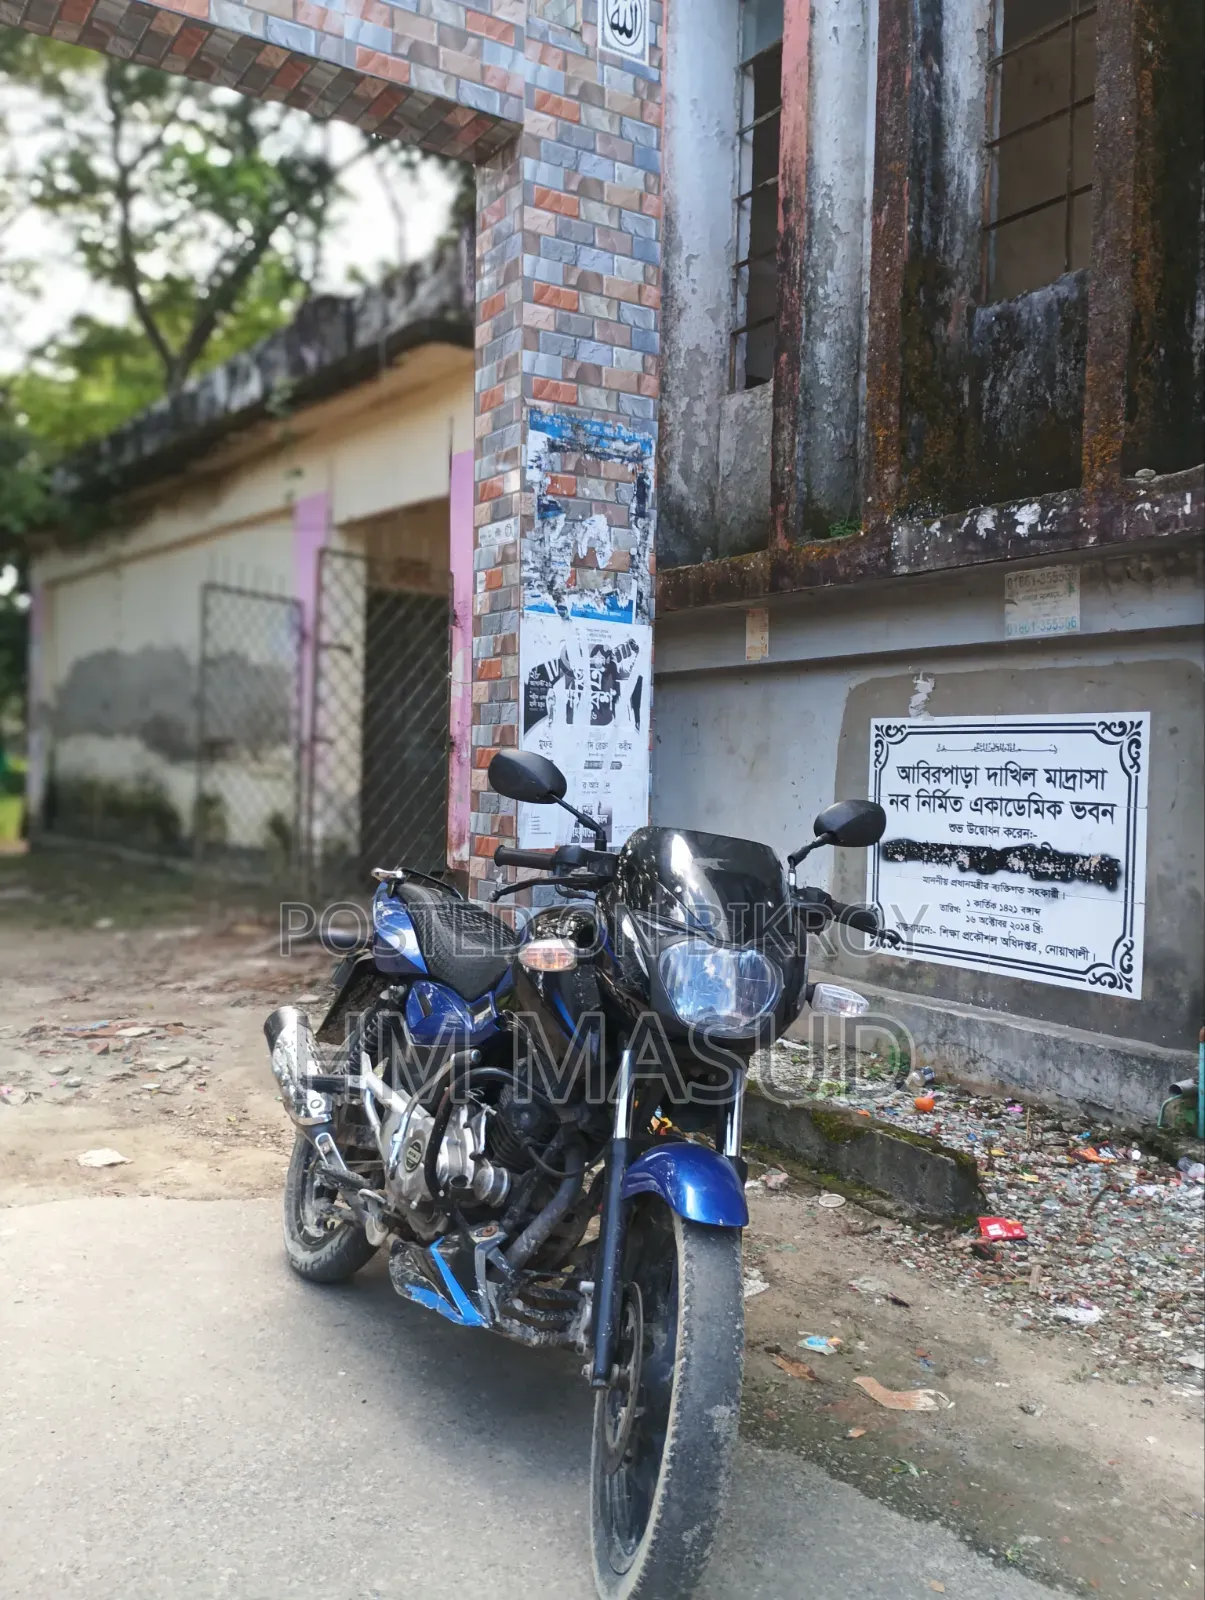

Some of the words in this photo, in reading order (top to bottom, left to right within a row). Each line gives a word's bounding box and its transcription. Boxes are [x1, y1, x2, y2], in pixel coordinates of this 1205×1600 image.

[897, 760, 980, 789] আবিরপাড়া
[985, 761, 1038, 787] দাখিল
[1043, 767, 1108, 792] মাদ্রাসা
[888, 794, 911, 812] নব
[915, 788, 964, 813] নির্মিত
[969, 792, 1064, 820] একাডেমিক
[1069, 800, 1118, 824] ভবন
[948, 822, 964, 833] শুভ
[966, 821, 1000, 837] উদ্বোধন
[922, 875, 949, 887] মাননীয়
[973, 898, 997, 911] কার্তিক
[999, 902, 1018, 914] ১৪২১
[966, 914, 976, 924] ১৬
[979, 916, 1007, 929] অক্টোবর
[1010, 920, 1030, 933] ২০১৪
[939, 925, 960, 939] শিক্ষা
[962, 929, 998, 946] প্রকৌশল
